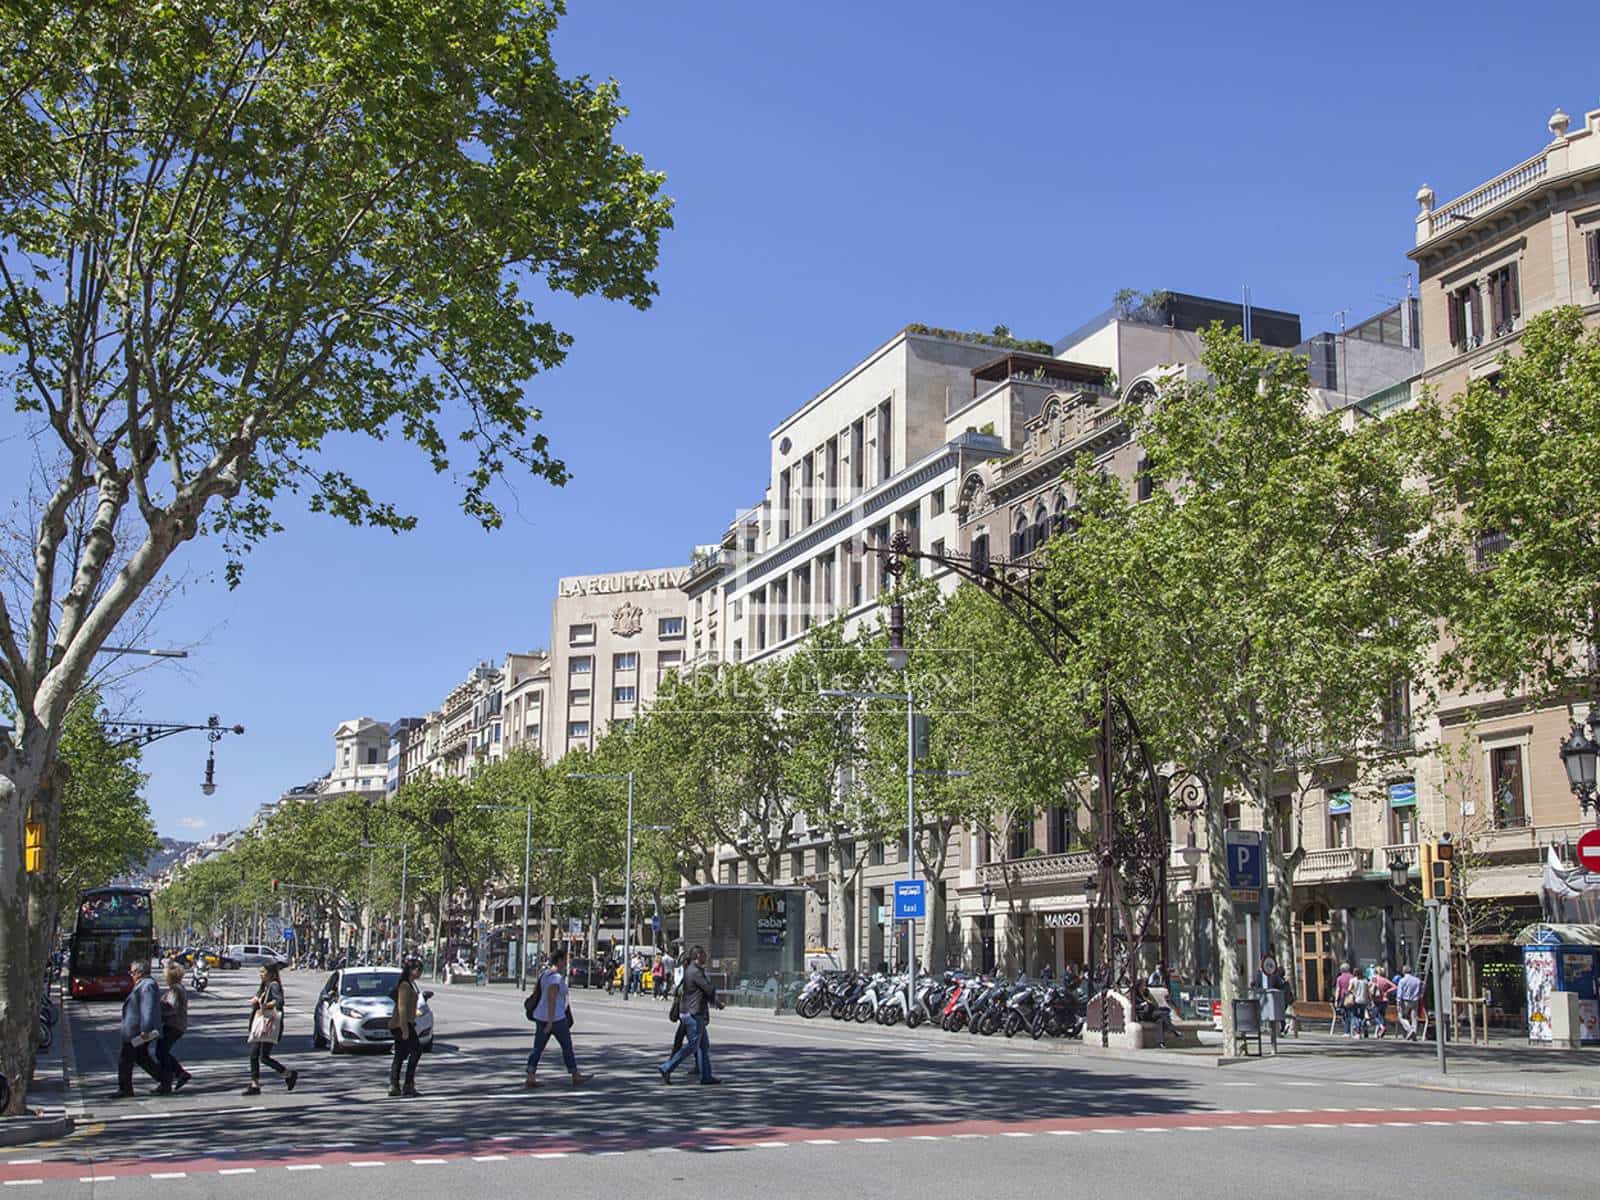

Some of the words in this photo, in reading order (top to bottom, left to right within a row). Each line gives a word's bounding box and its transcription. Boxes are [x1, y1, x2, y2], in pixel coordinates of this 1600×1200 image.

[559, 578, 586, 598] LA
[1237, 846, 1250, 873] P
[903, 903, 917, 913] taxi
[1044, 912, 1081, 927] MANGO
